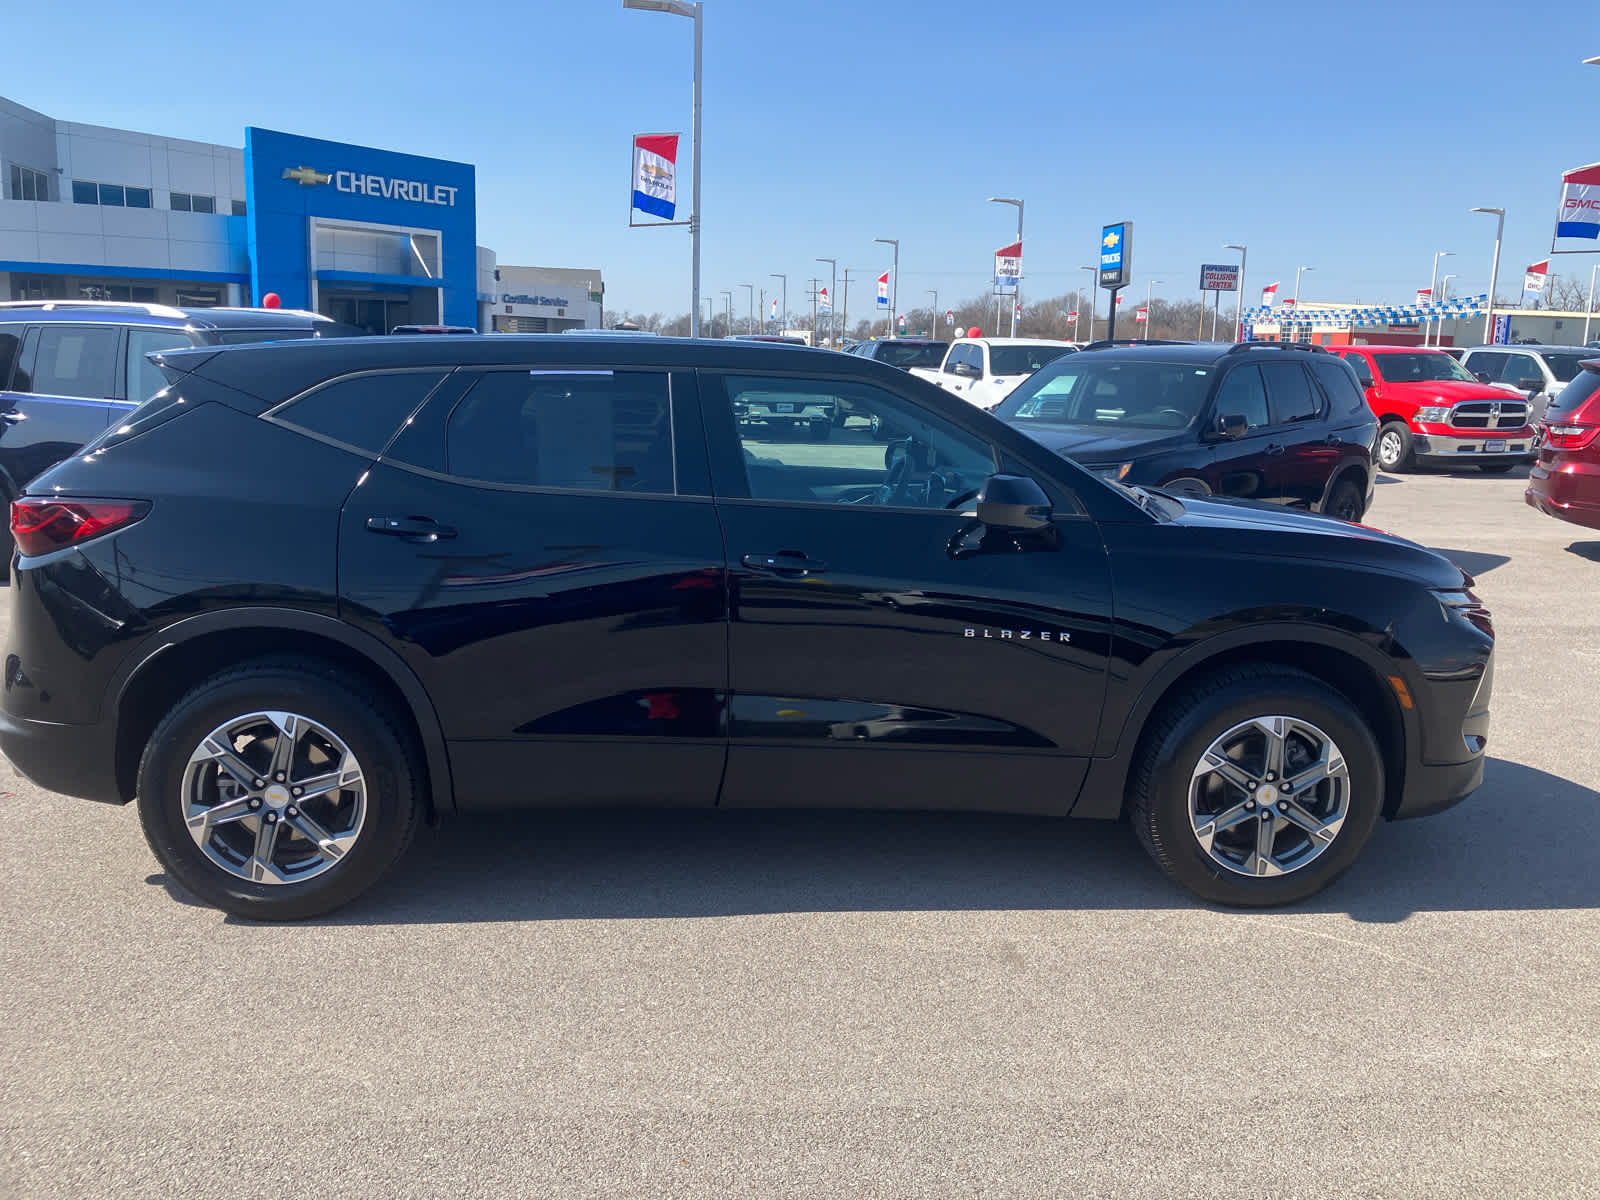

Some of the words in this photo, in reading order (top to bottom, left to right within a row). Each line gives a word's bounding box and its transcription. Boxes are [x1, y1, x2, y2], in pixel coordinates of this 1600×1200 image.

[335, 170, 458, 206] CHEVROLET
[1565, 198, 1600, 210] GMC
[1205, 272, 1237, 280] COLLISION
[1208, 280, 1233, 289] CENTER
[503, 293, 538, 305] Certified
[540, 295, 568, 307] Service
[964, 628, 1072, 642] BLAZER
